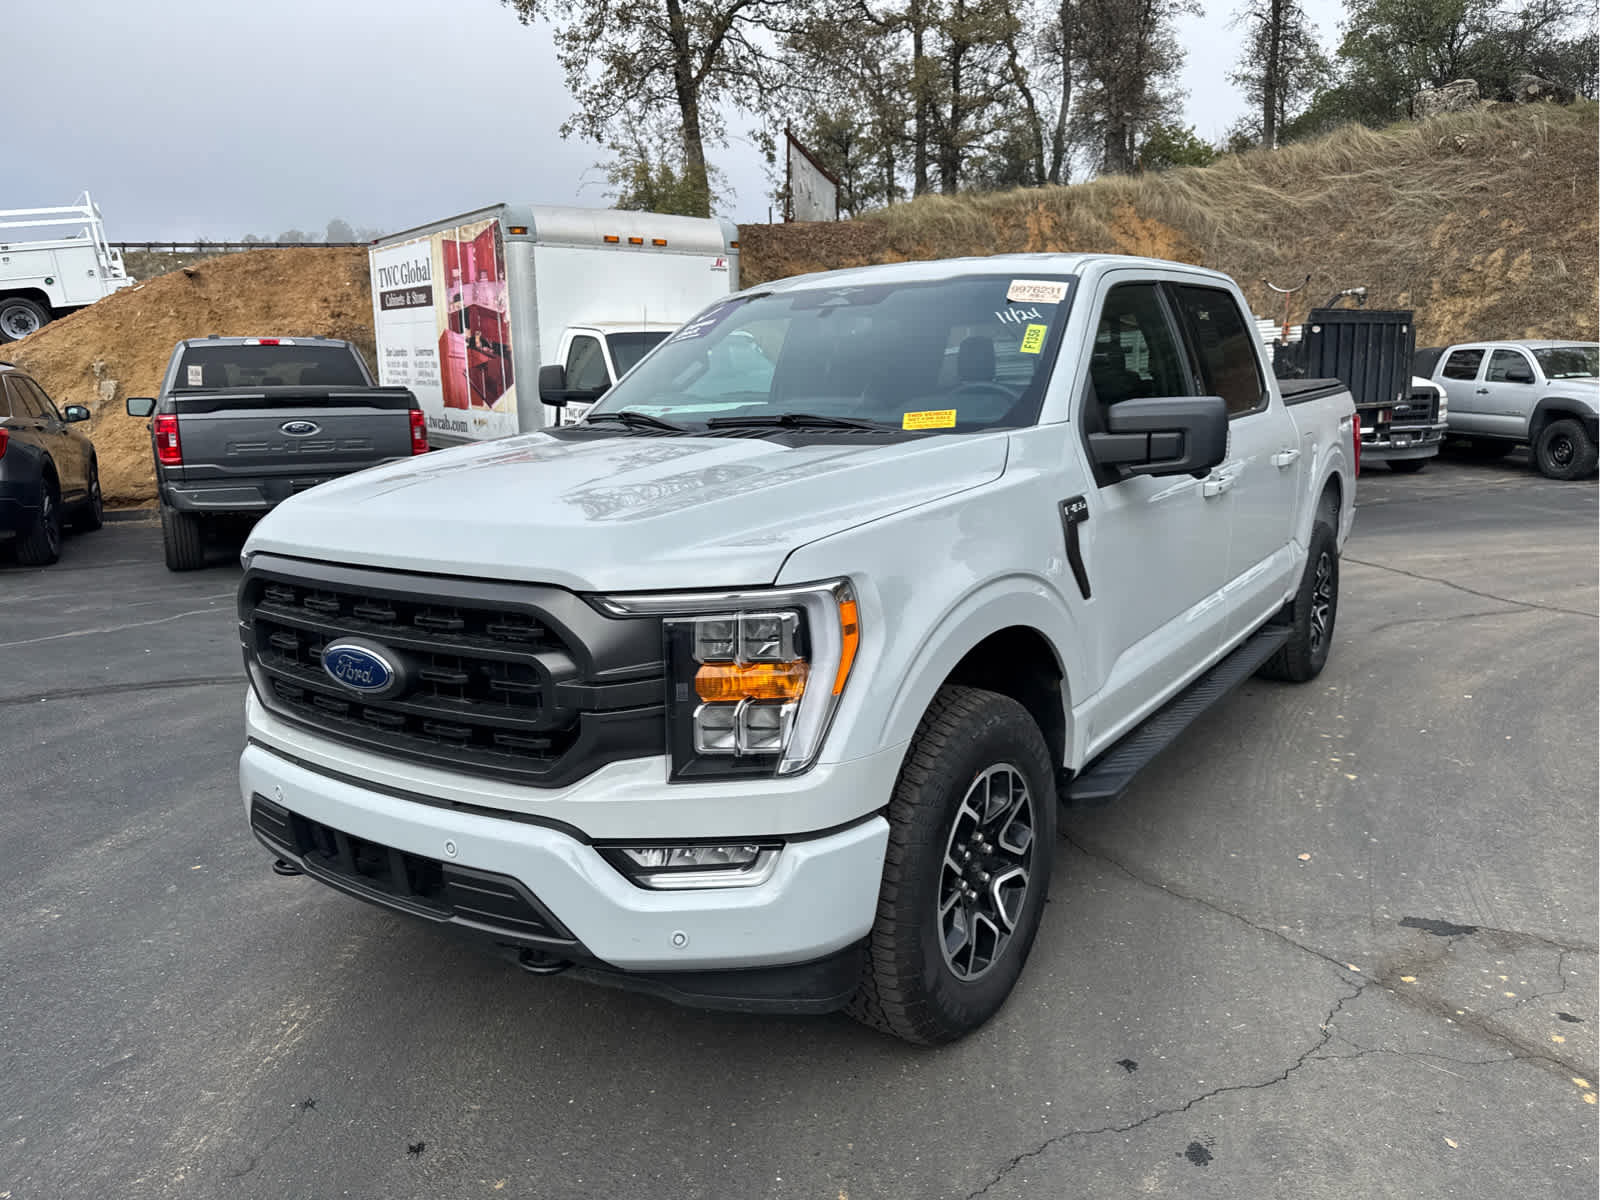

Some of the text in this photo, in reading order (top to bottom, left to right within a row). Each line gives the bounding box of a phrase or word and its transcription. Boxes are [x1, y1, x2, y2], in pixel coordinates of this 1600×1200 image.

[378, 256, 432, 289] TWC Global
[336, 654, 373, 683] Ford
